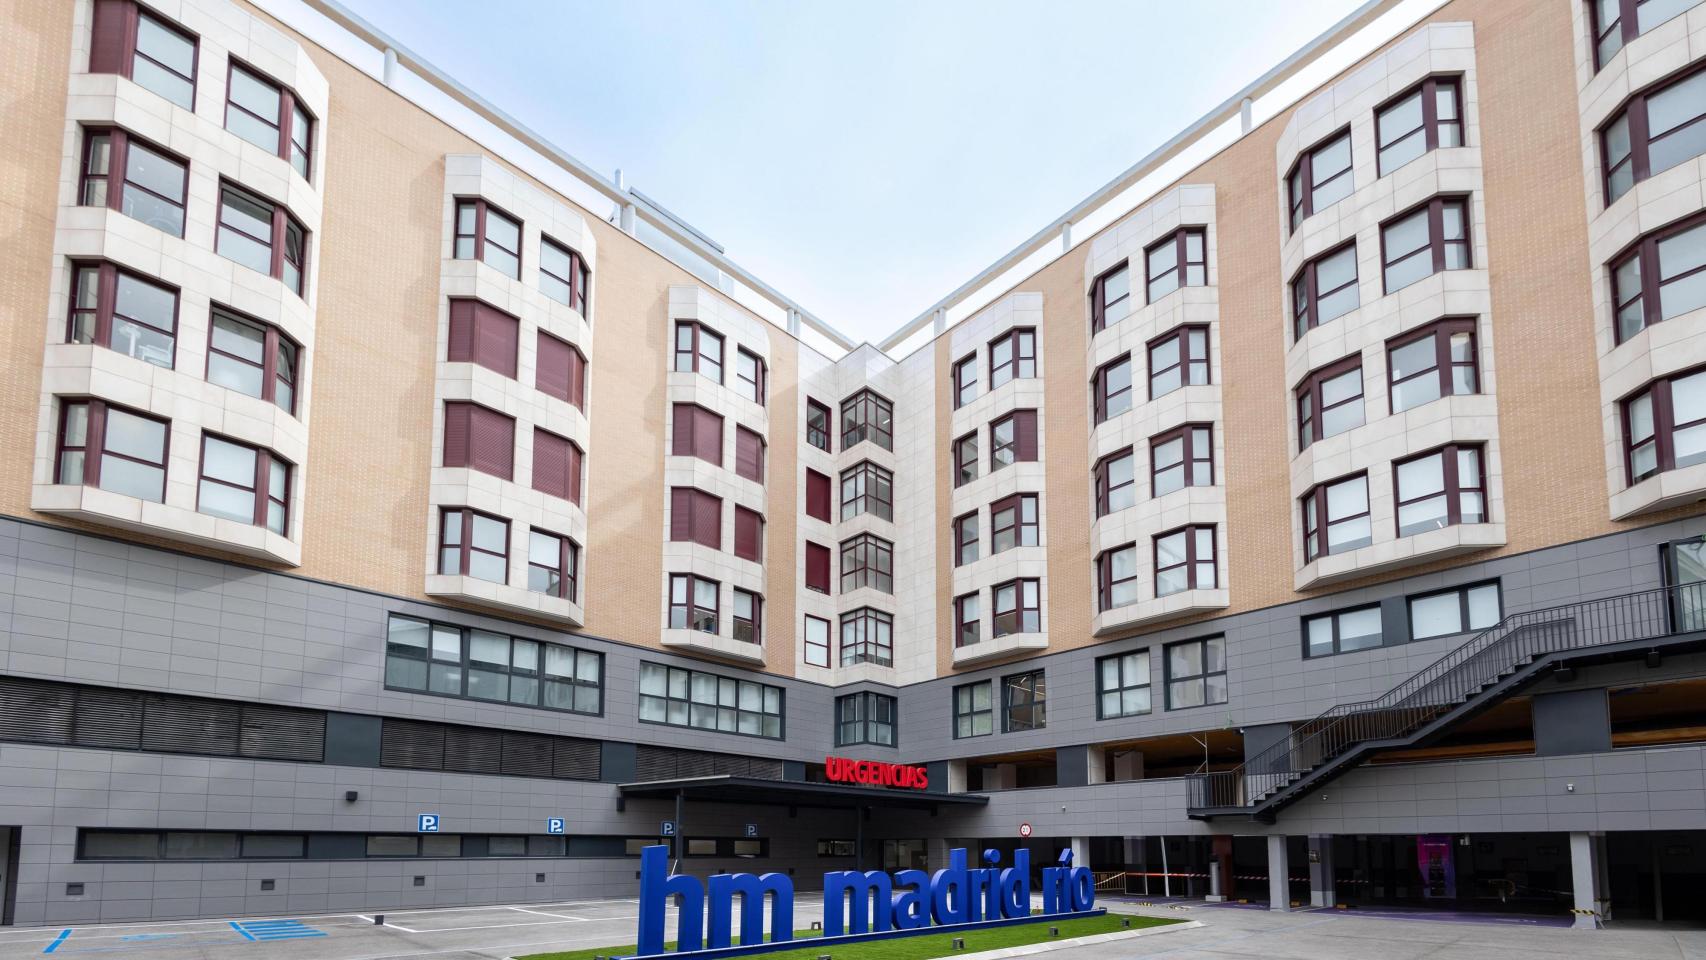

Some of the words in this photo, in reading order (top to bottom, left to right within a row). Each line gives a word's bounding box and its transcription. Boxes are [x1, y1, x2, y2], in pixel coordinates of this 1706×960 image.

[825, 757, 928, 789] URGENCIAS
[422, 816, 435, 831] P
[550, 819, 561, 833] P
[663, 822, 673, 835] P
[637, 845, 794, 955] hm
[824, 848, 1030, 937] madrid
[1042, 848, 1095, 915] río
